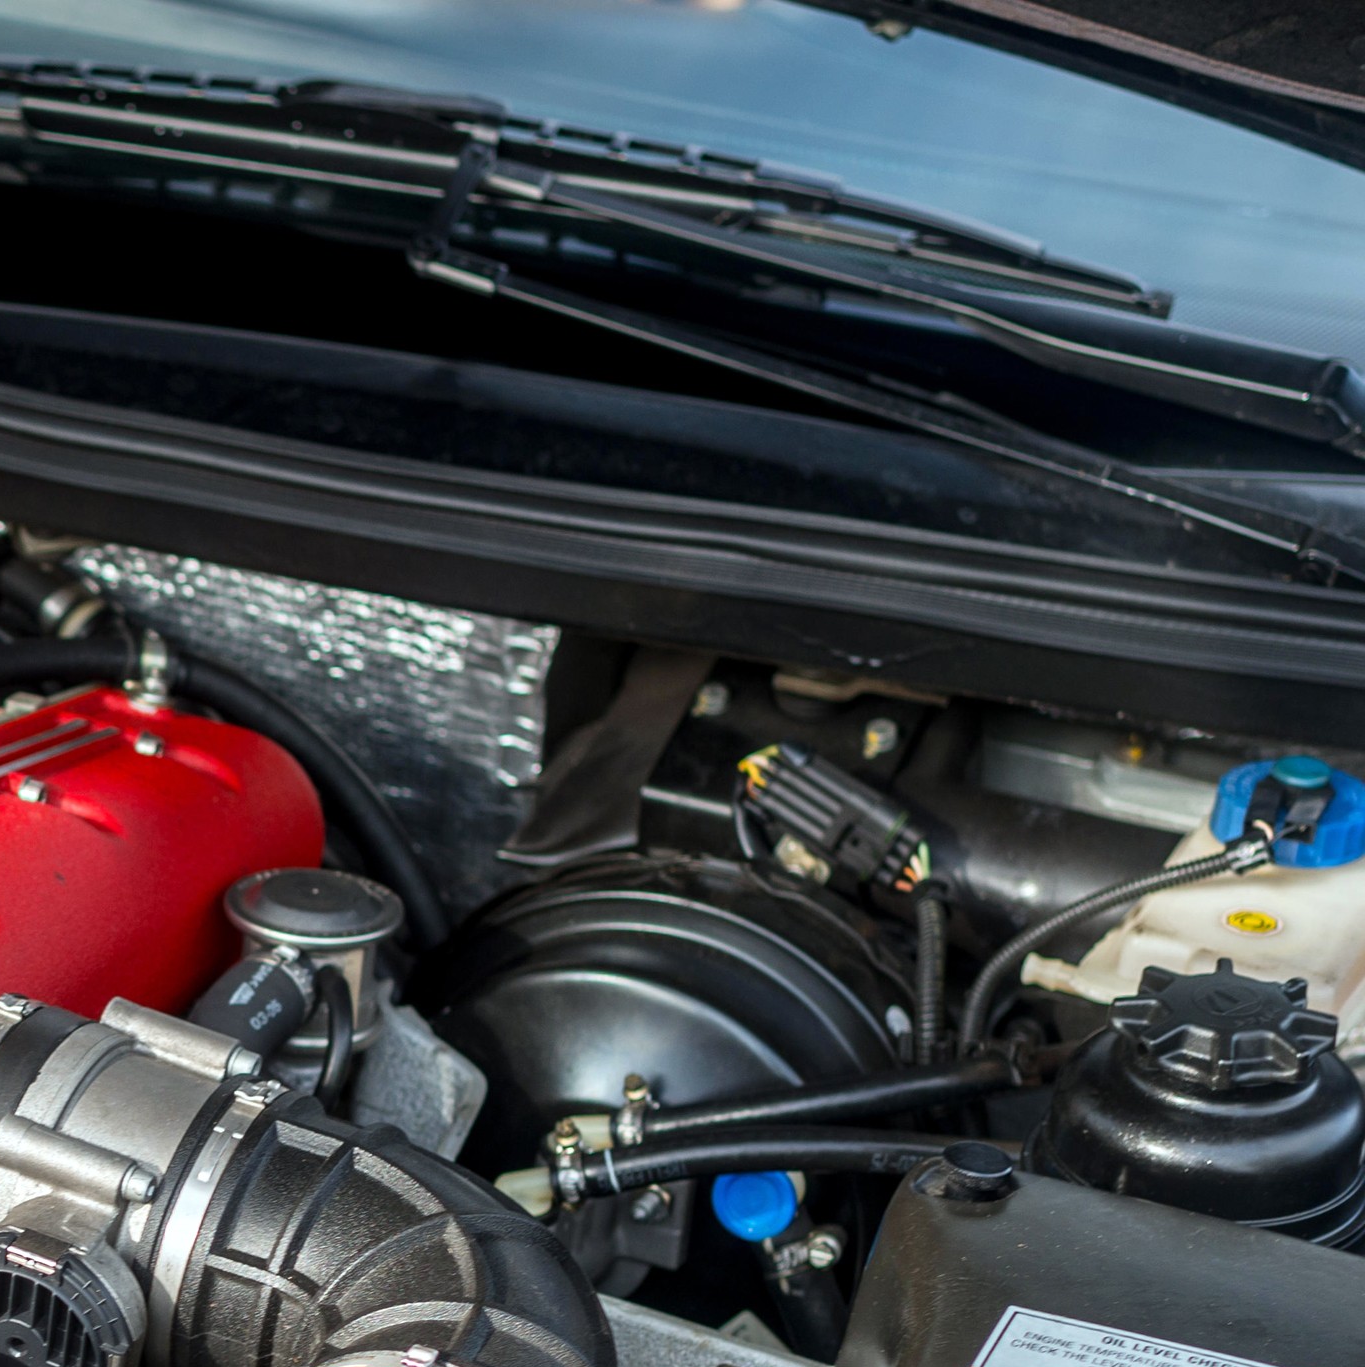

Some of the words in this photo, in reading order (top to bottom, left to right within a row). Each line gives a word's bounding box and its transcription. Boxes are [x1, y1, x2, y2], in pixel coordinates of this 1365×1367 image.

[1010, 1339, 1060, 1355] CHECK
[1062, 1349, 1090, 1362] THE
[1023, 1331, 1076, 1348] ENGINE
[1101, 1336, 1130, 1347] OIL
[1133, 1343, 1184, 1360] LEVEL
